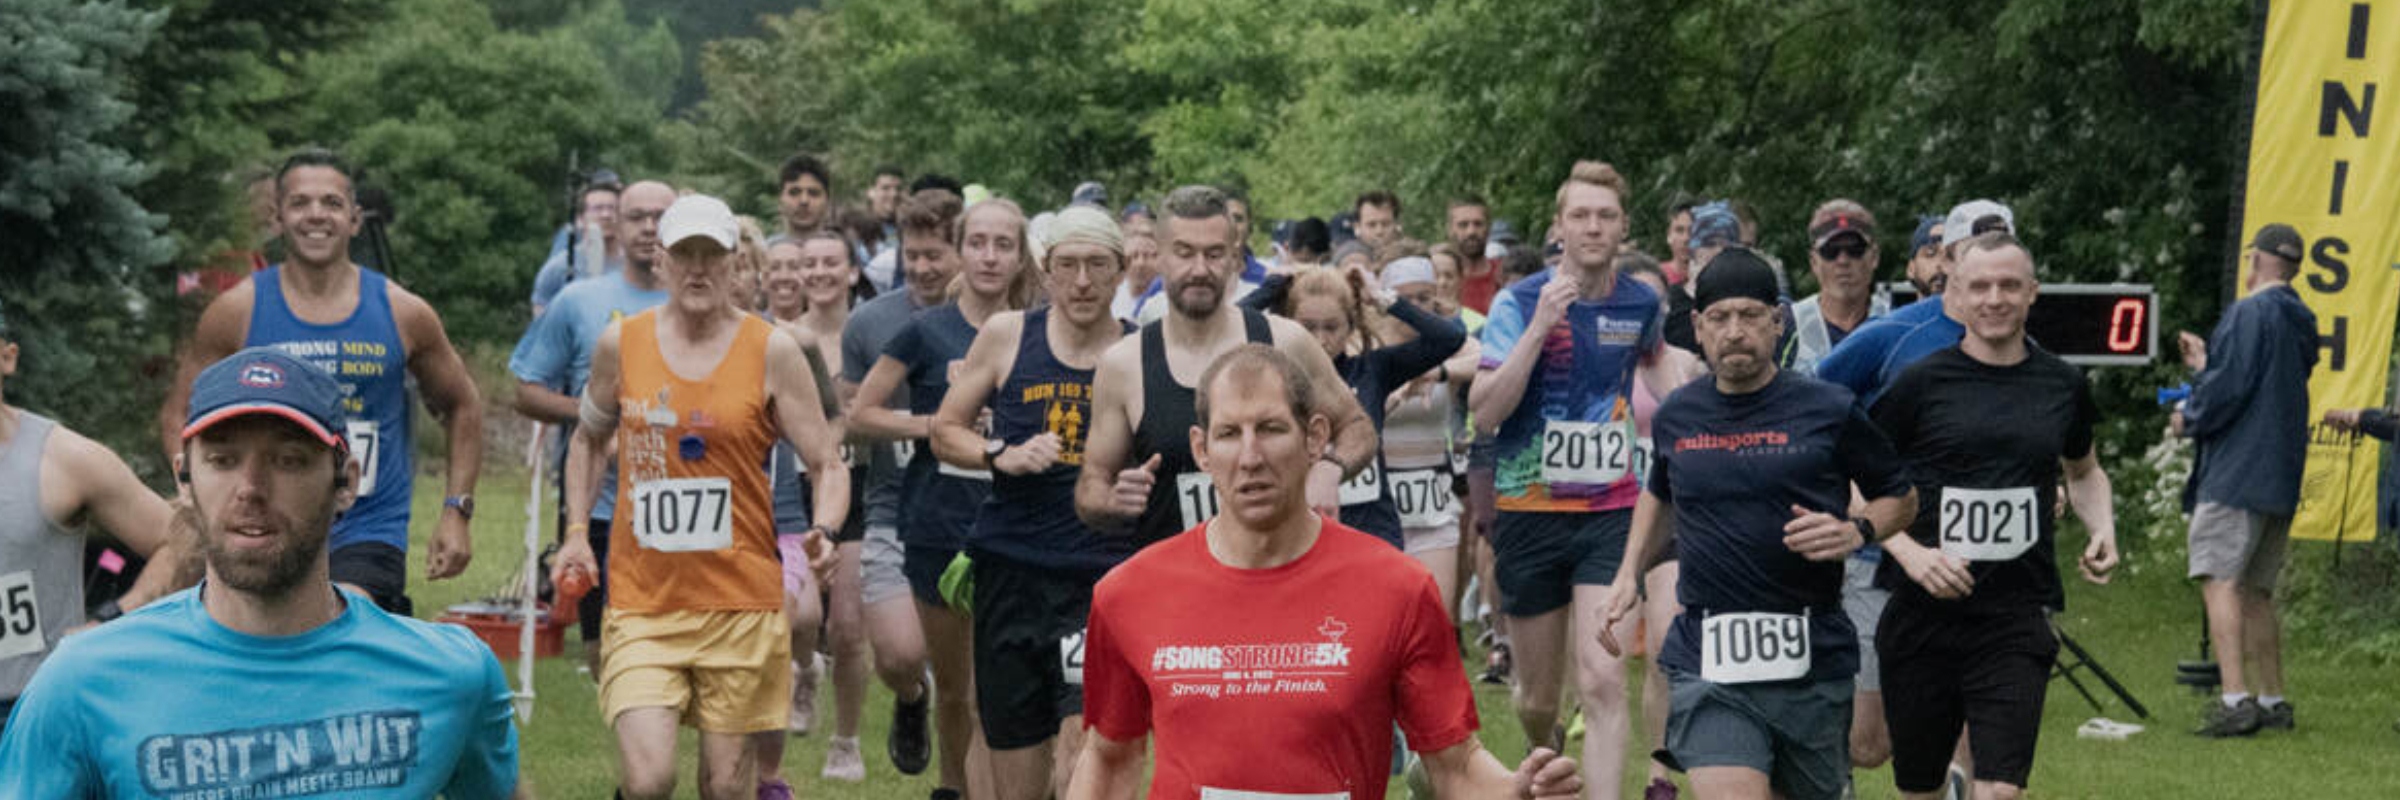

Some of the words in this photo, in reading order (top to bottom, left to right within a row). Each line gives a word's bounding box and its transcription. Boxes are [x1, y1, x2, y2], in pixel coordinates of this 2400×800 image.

[2108, 298, 2145, 351] 0
[342, 341, 387, 356] MIND
[342, 360, 384, 376] BODY
[1546, 430, 1625, 469] 2012
[640, 488, 728, 535] 1077
[1945, 498, 2033, 545] 2021
[0, 584, 36, 640] 5
[1708, 617, 1806, 666] 1069
[1172, 682, 1220, 698] Strong
[1226, 683, 1242, 695] to
[1246, 681, 1271, 694] the
[325, 714, 415, 767] WIT
[286, 771, 337, 794] MEETS
[343, 767, 400, 787] BRAWN
